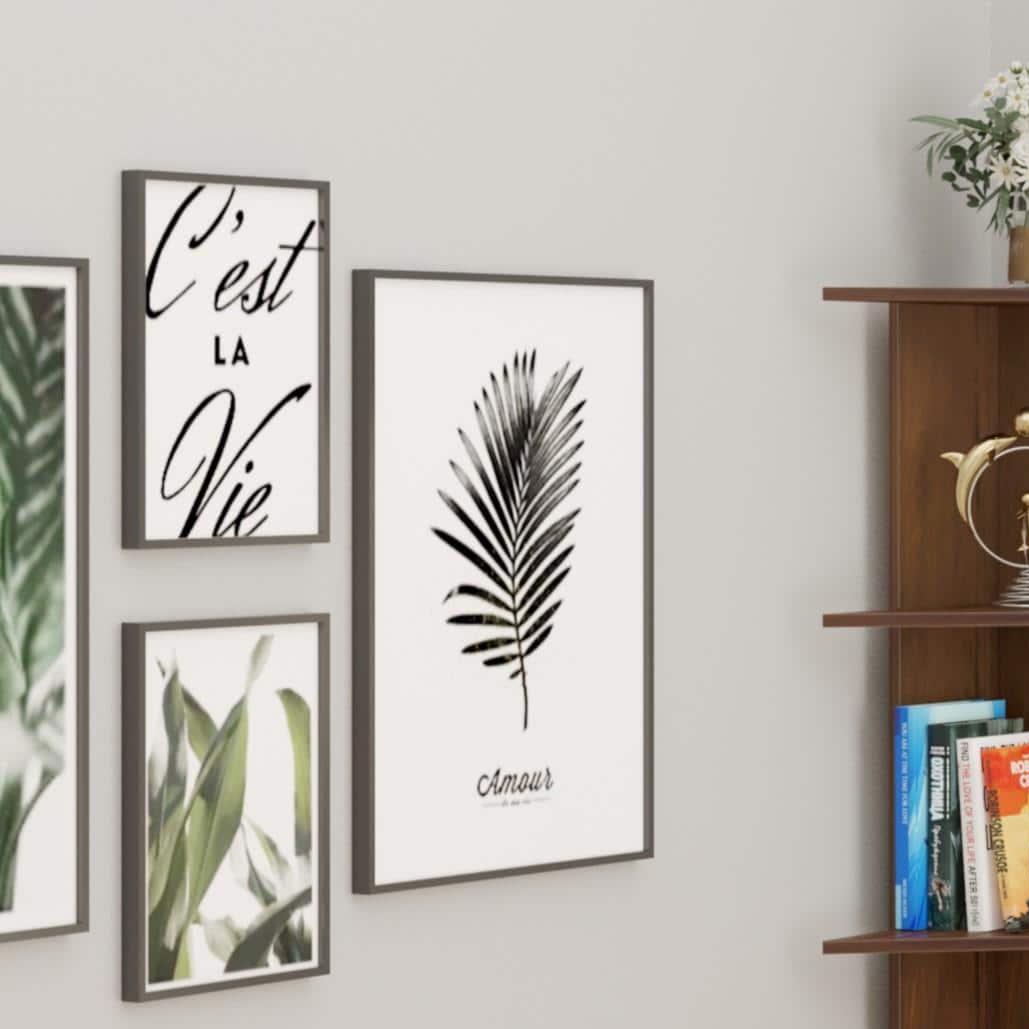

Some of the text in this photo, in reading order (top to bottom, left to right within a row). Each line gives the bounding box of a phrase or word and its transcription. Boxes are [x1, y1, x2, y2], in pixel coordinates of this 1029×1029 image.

[145, 185, 322, 319] C'est
[213, 335, 250, 366] LA
[160, 383, 312, 538] Vie
[960, 742, 970, 762] FIND
[476, 766, 554, 797] Amour
[961, 763, 971, 780] THE
[962, 781, 973, 805] LOVE
[963, 806, 974, 818] OF
[988, 789, 1003, 838] ROBINSON
[965, 820, 975, 844] YOUR
[966, 845, 977, 864] LIFE
[993, 838, 1008, 873] CRUSOE
[967, 866, 978, 893] AFTER
